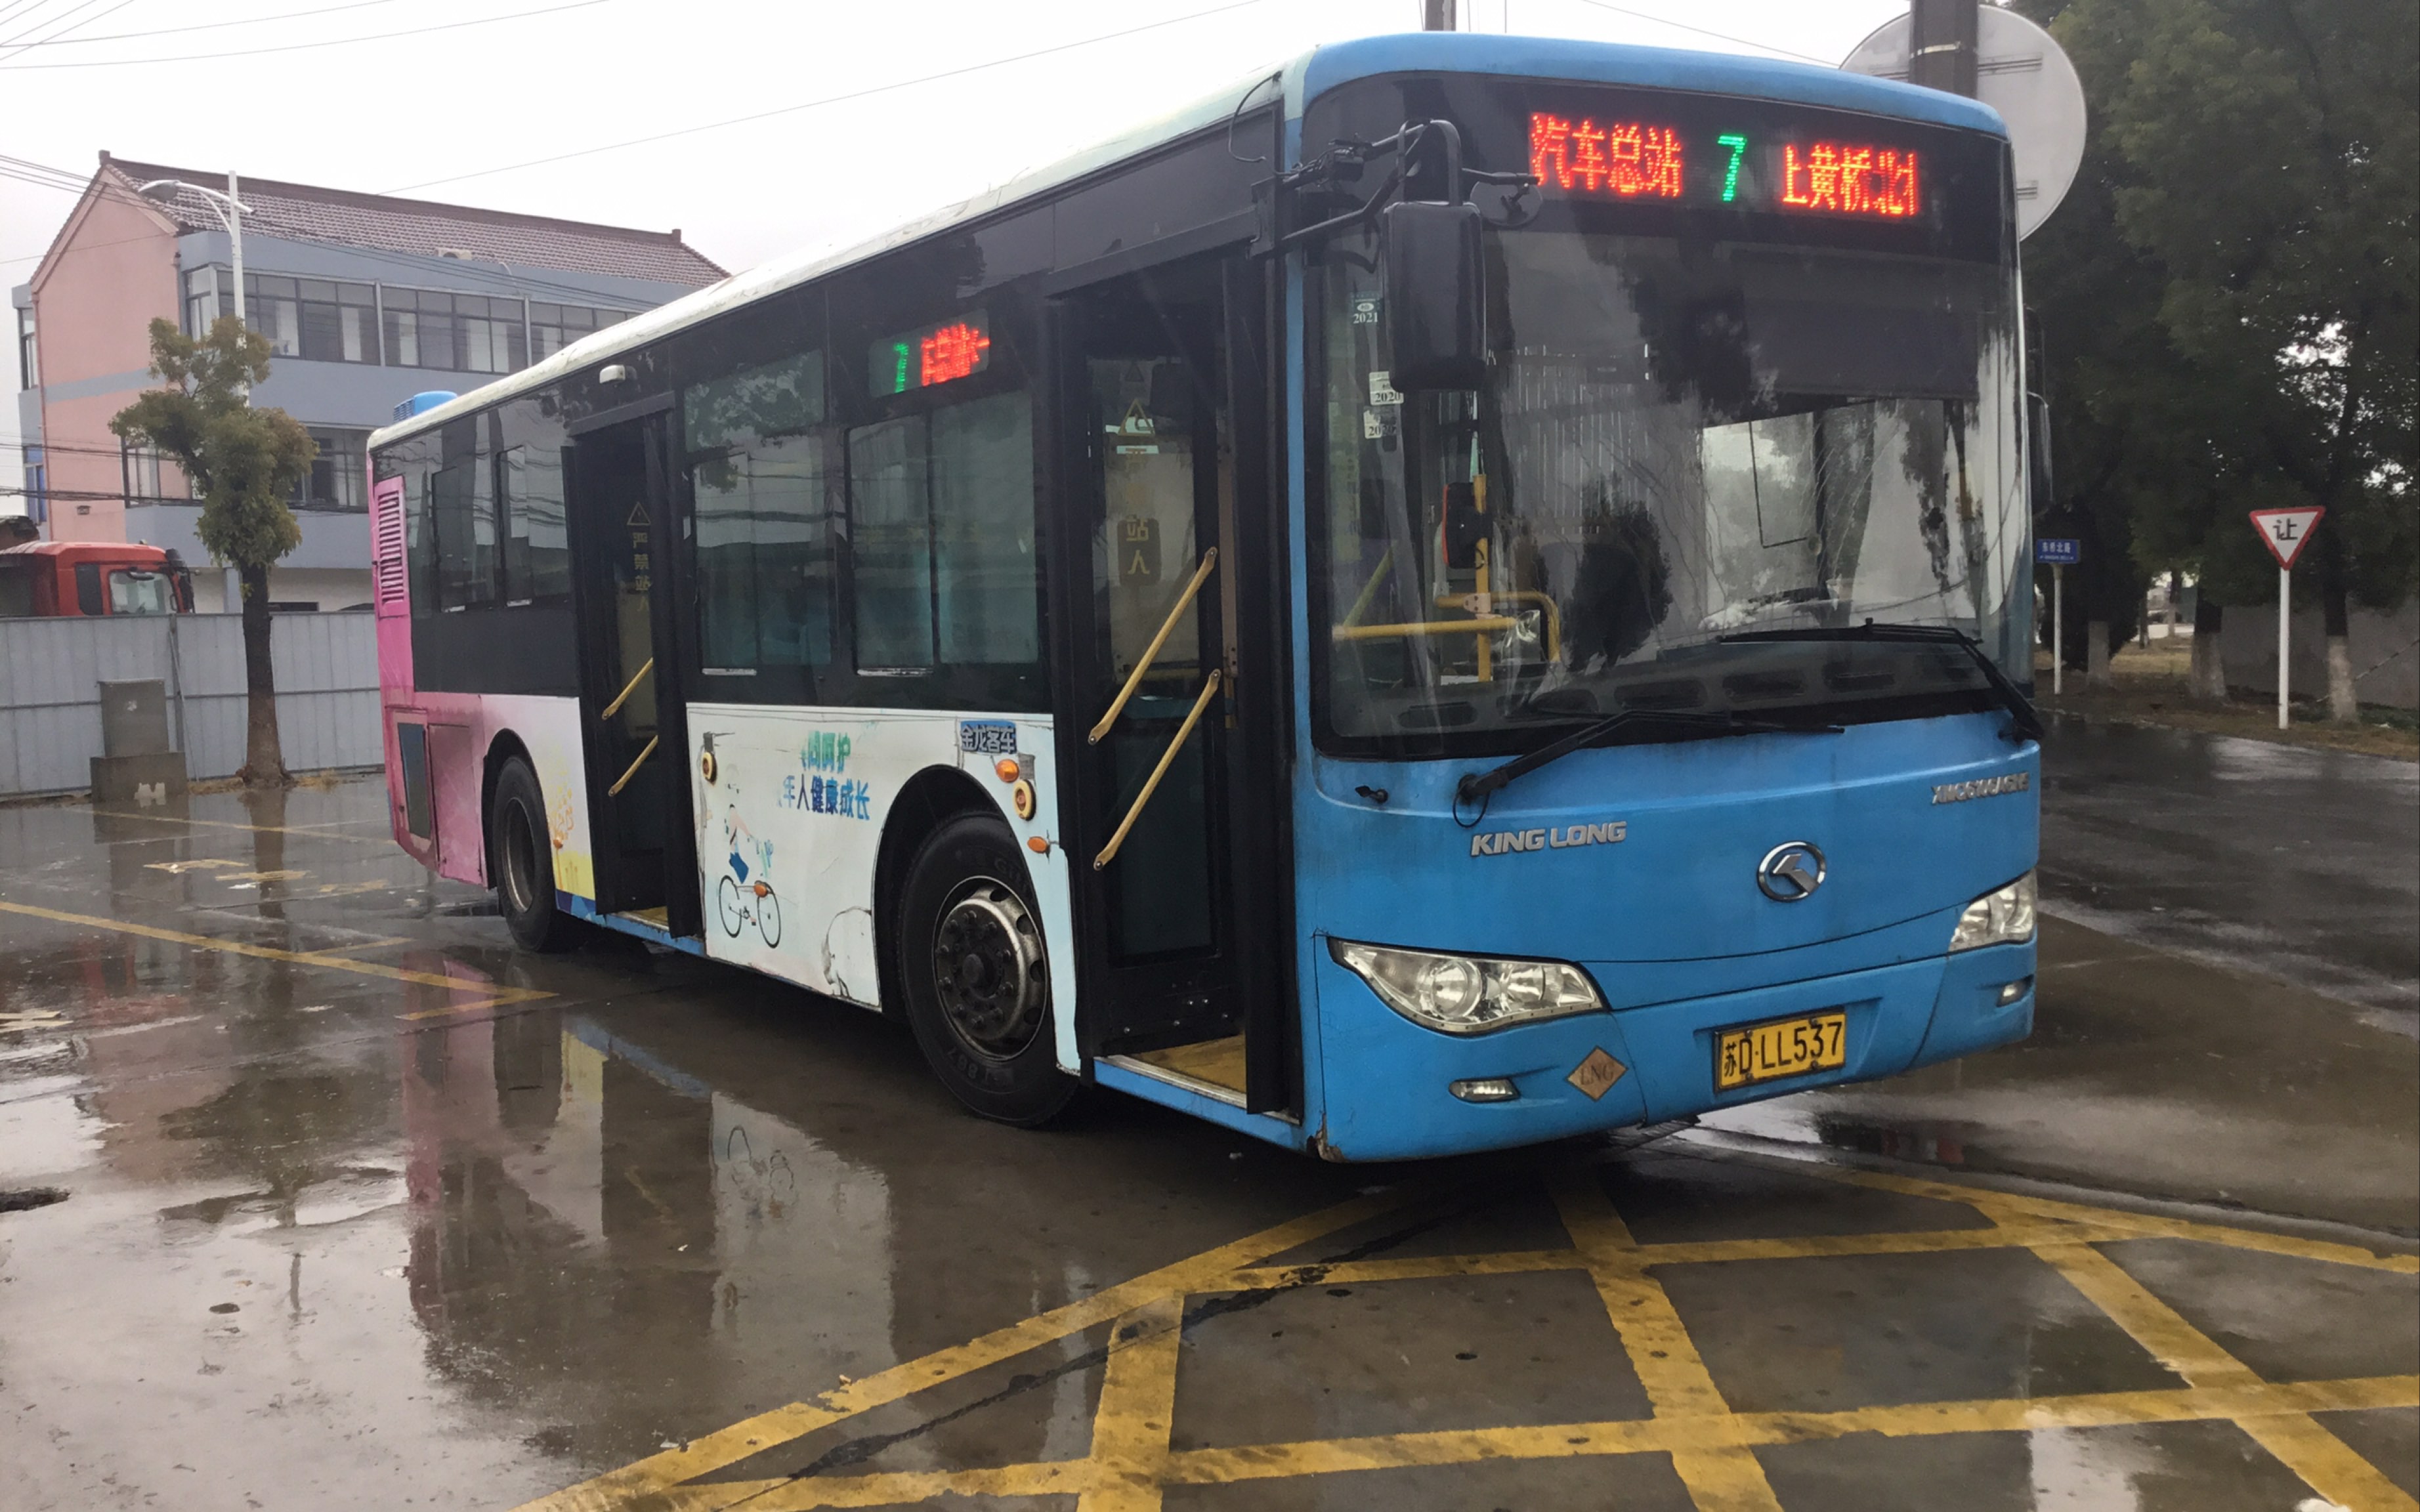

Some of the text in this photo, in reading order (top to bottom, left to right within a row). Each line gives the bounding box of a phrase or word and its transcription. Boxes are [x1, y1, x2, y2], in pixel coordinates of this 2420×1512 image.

[1531, 112, 1682, 198] 汽车总站
[1717, 133, 1748, 201] 7
[1353, 312, 1378, 324] 2021
[893, 342, 909, 393] 7
[1375, 391, 1401, 403] 2020
[2273, 518, 2297, 540] 让
[961, 724, 1015, 753] 金龙客车
[778, 774, 870, 820] 年人健康成长
[1470, 820, 1627, 856] KING LONG
